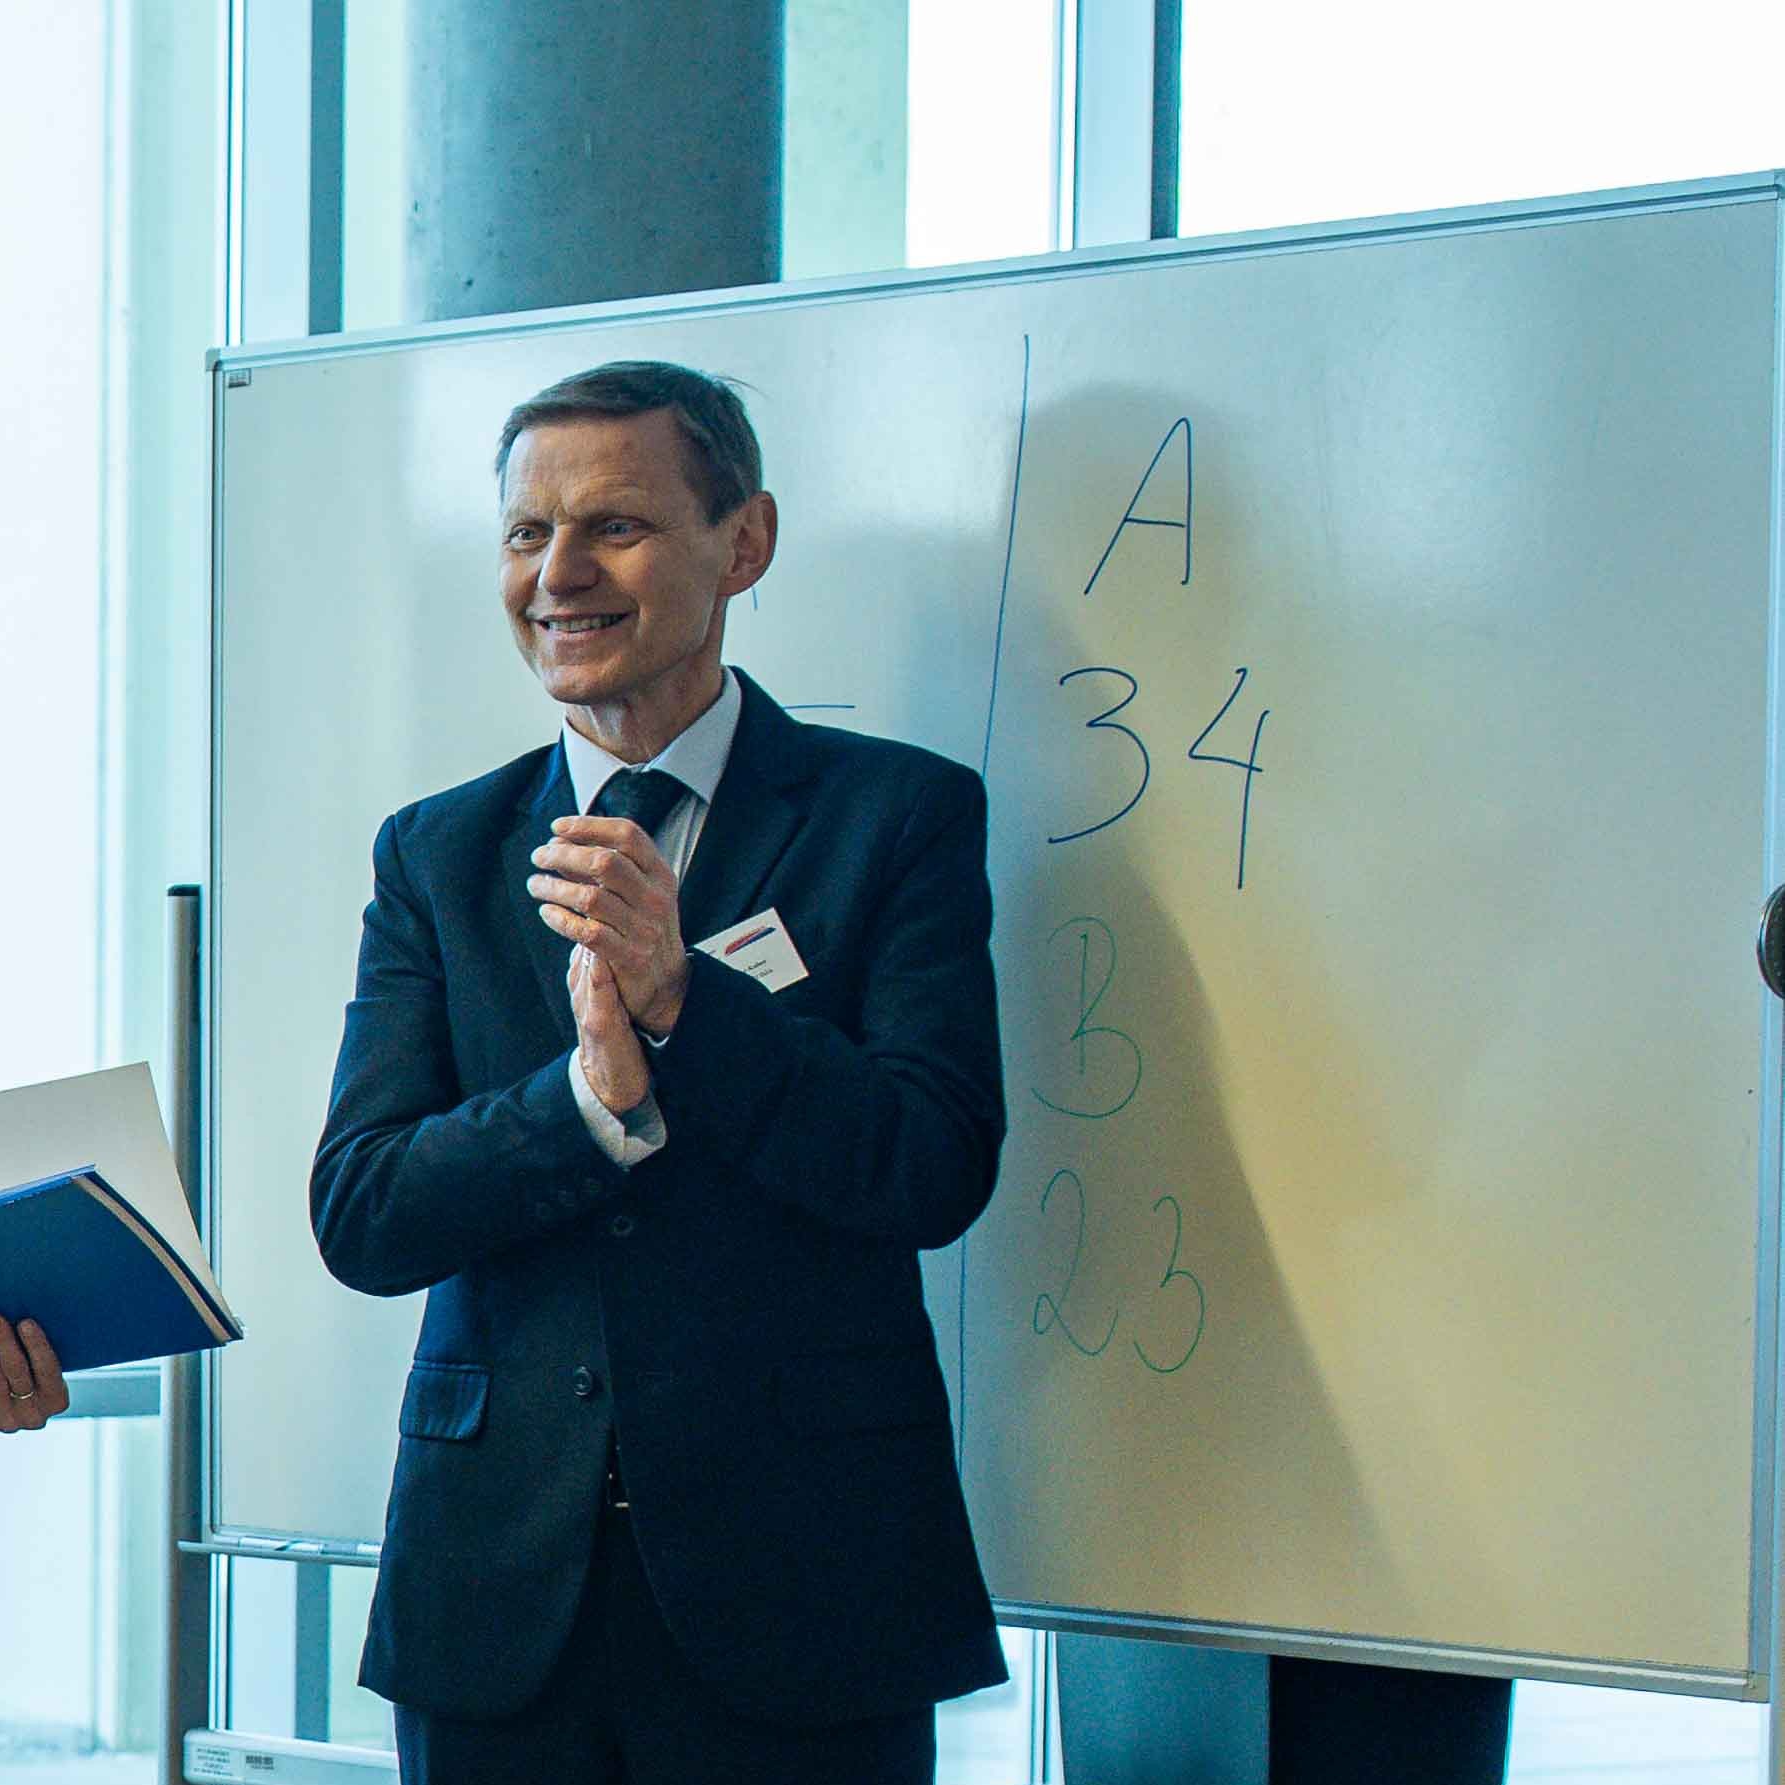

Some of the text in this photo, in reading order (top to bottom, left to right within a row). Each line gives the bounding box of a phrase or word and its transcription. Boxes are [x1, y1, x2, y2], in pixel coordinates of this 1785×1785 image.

[1083, 416, 1193, 596] A
[1047, 666, 1270, 891] 34
[1029, 914, 1143, 1119] B
